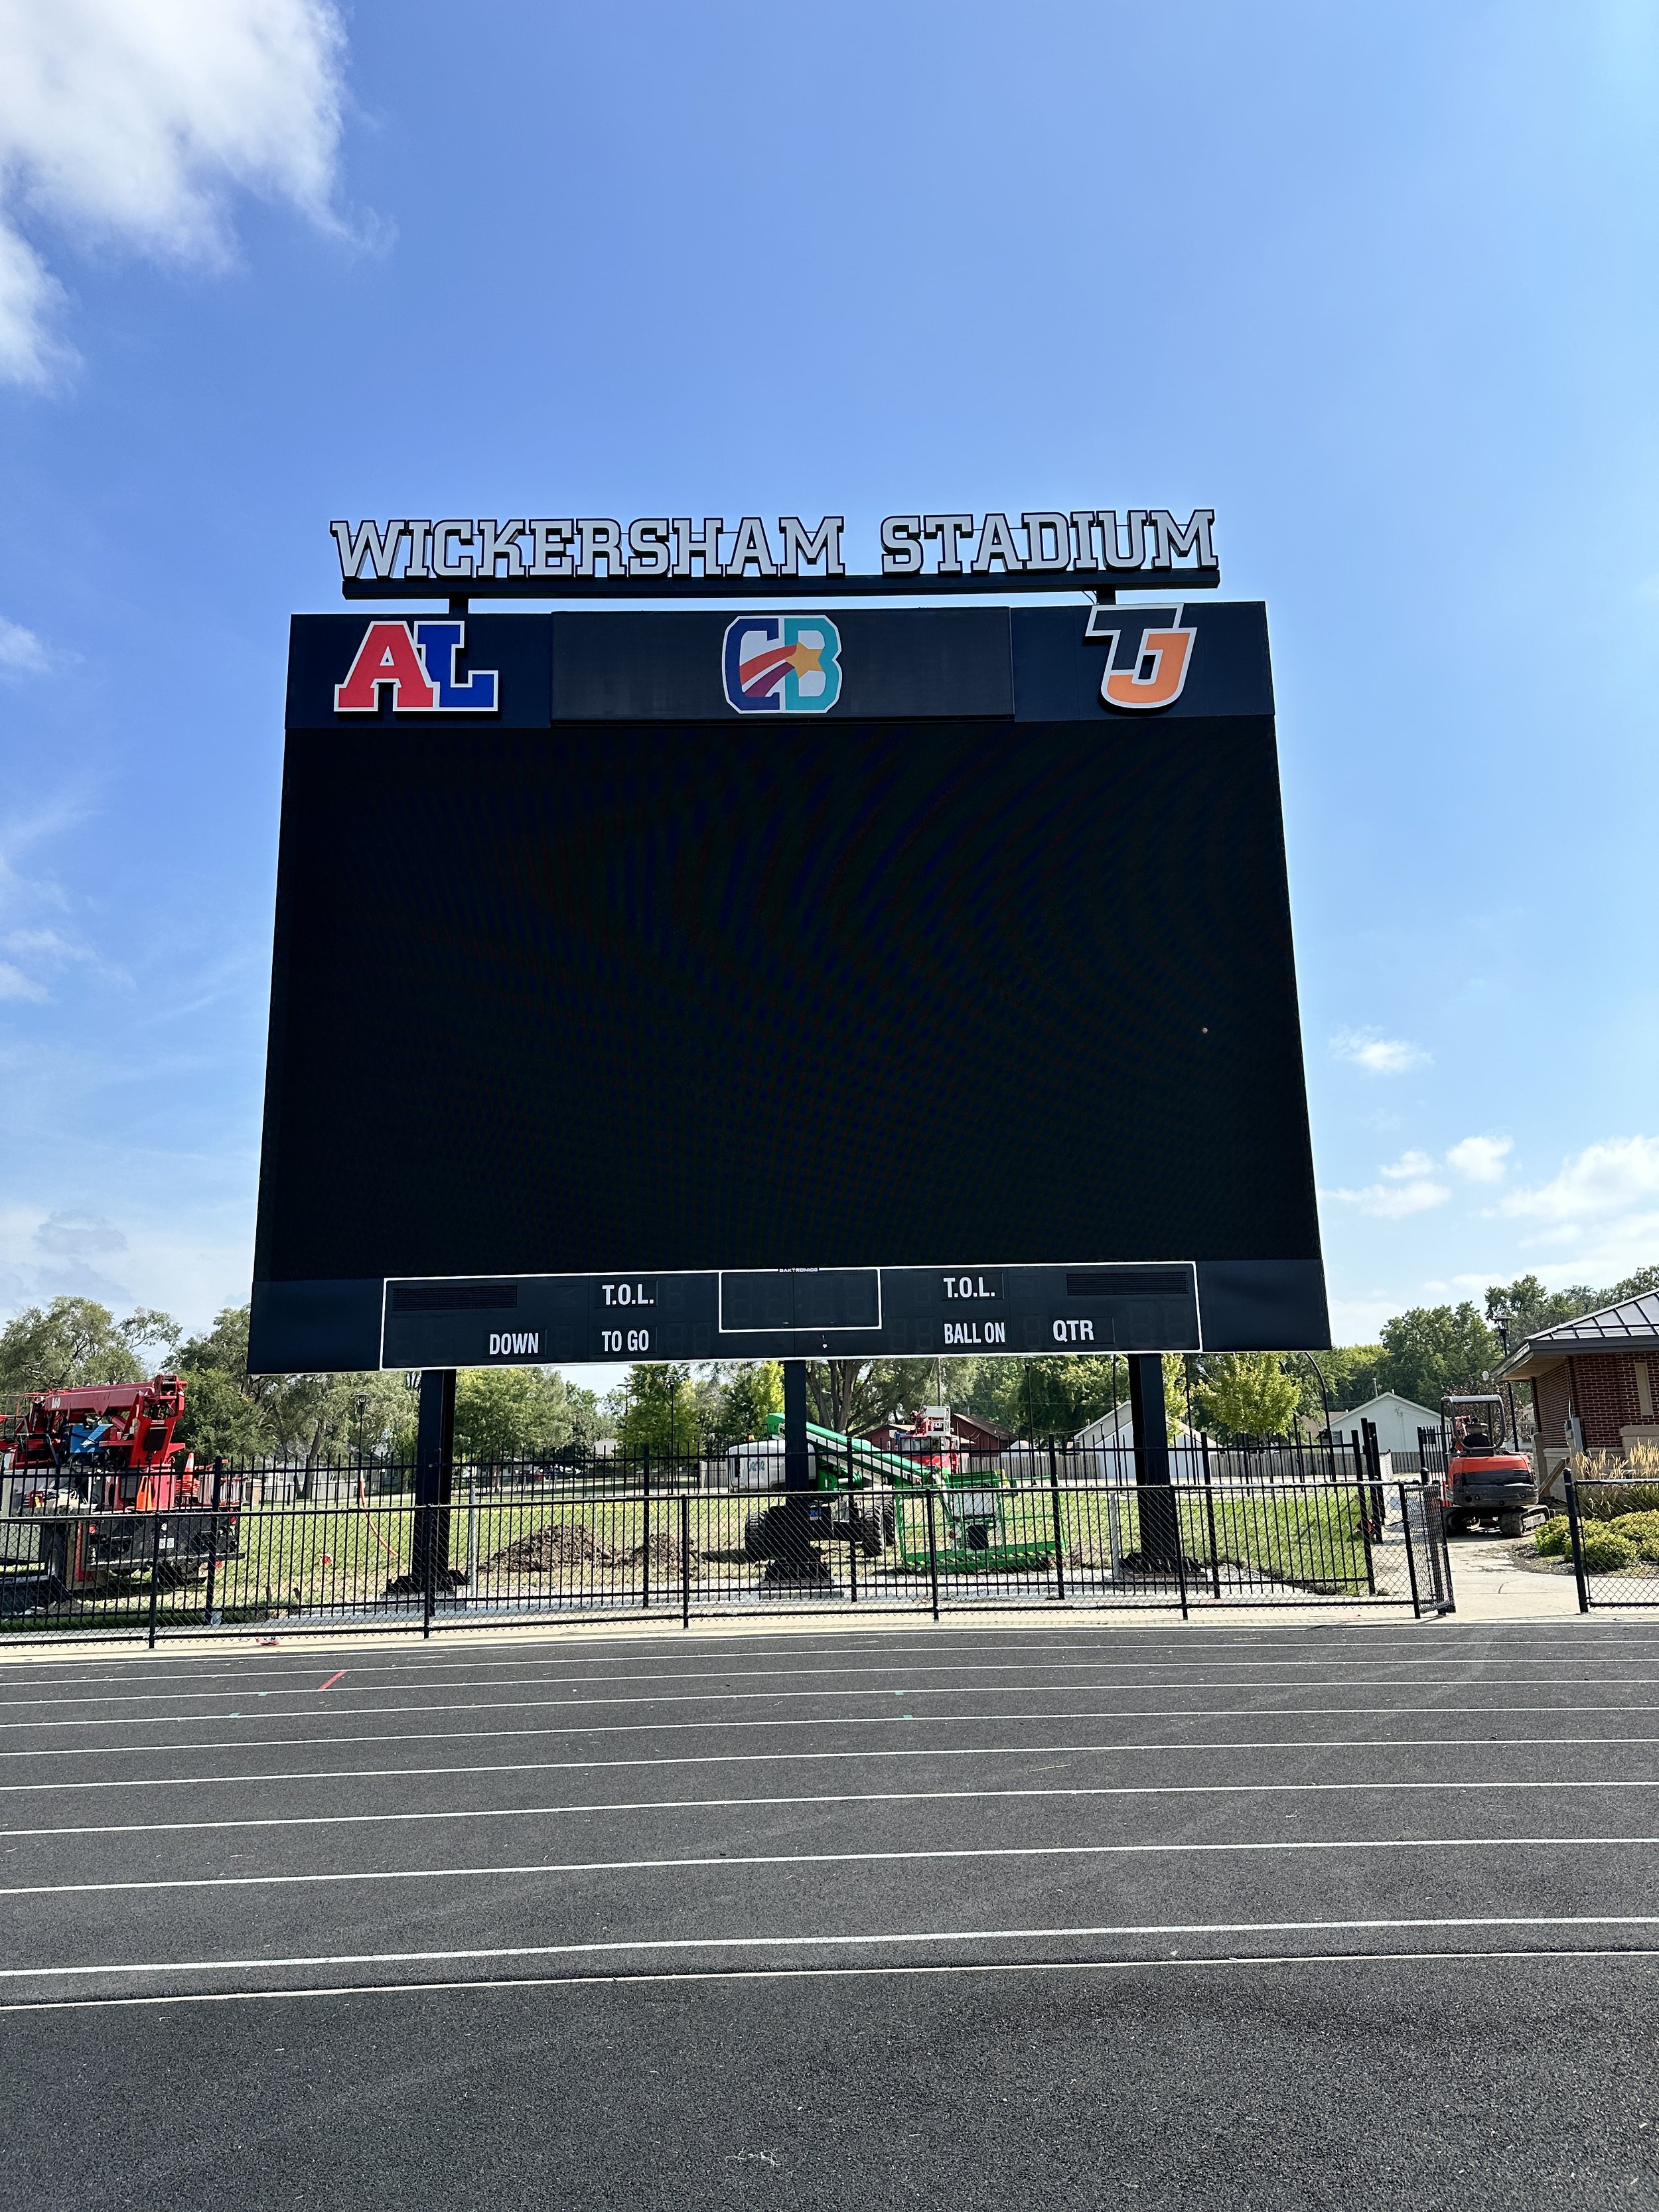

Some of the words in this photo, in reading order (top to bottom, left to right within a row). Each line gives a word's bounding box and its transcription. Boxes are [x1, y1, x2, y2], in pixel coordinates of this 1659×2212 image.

[330, 516, 845, 580] WICKERSHAM
[880, 509, 1219, 573] STADIUM
[334, 621, 498, 711] AL
[602, 1284, 654, 1305] T.O.L.
[943, 1276, 995, 1298] T.O.L.
[601, 1330, 622, 1352] TO
[627, 1329, 649, 1351] GO
[944, 1323, 981, 1345] BALL
[984, 1321, 1005, 1343] ON
[1052, 1319, 1094, 1343] QTR
[489, 1333, 539, 1355] DOWN
